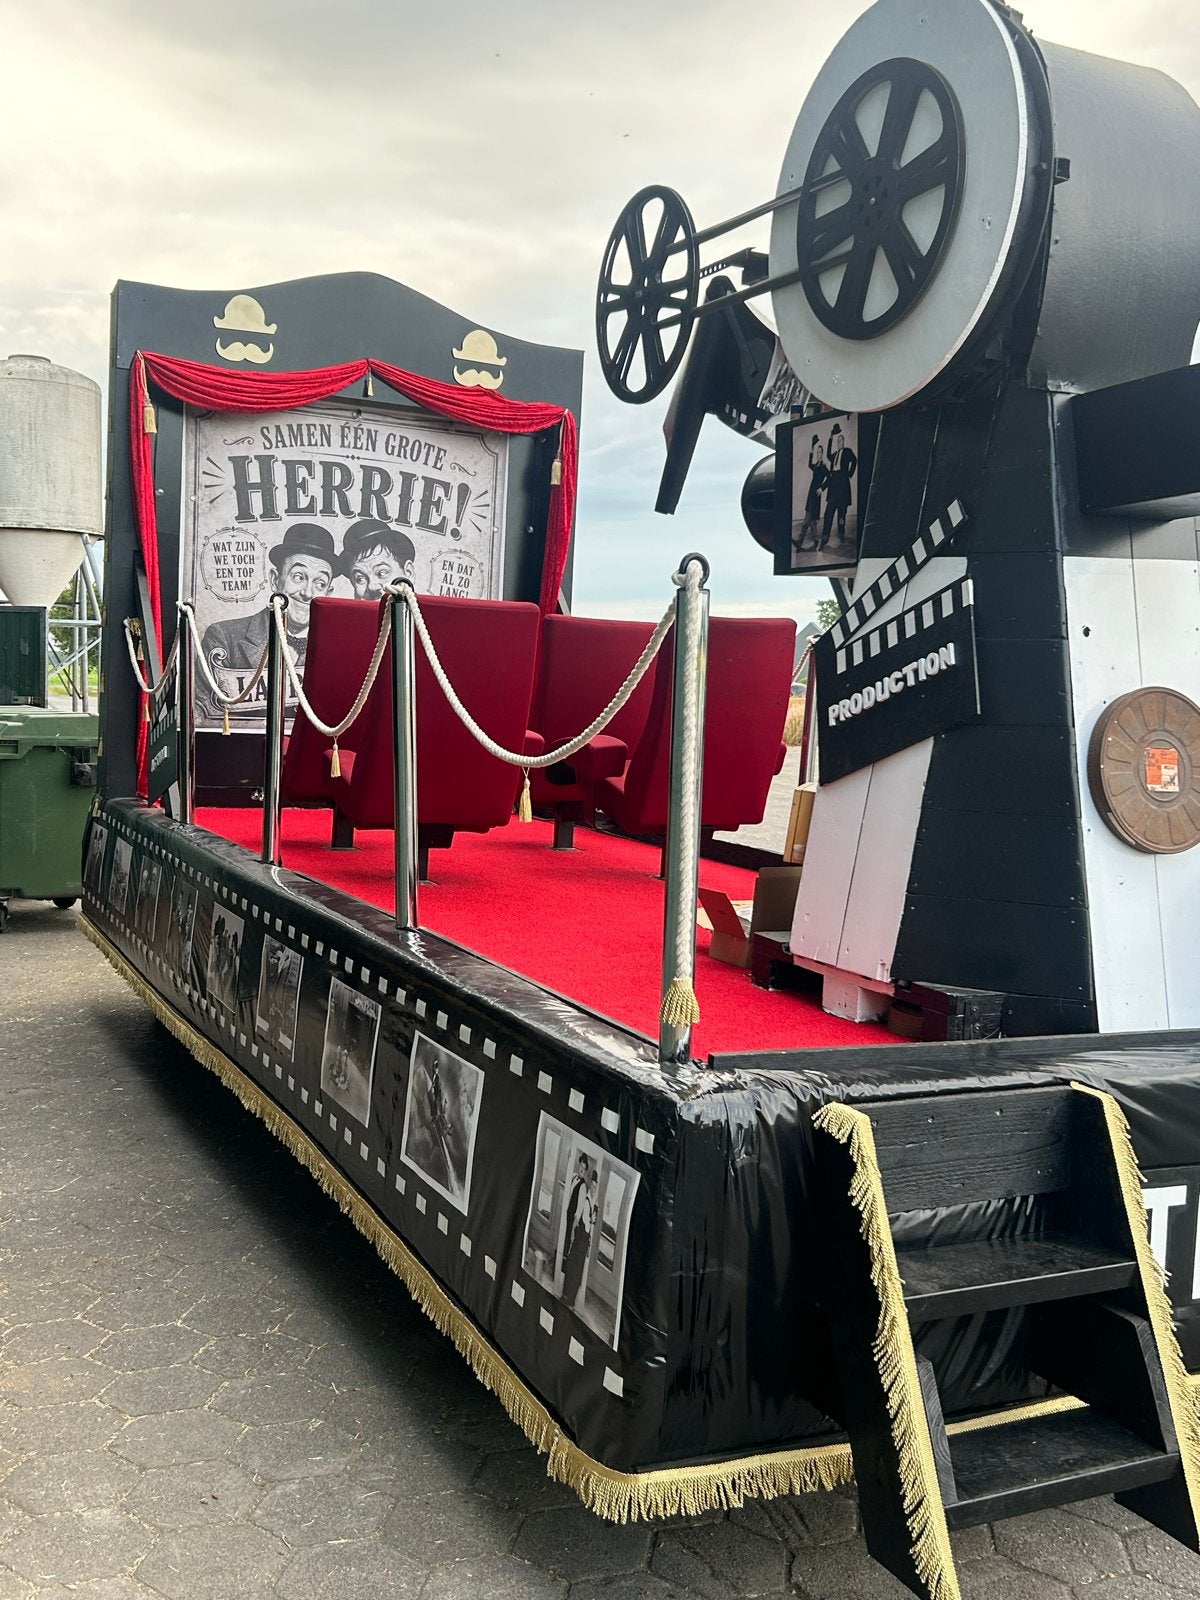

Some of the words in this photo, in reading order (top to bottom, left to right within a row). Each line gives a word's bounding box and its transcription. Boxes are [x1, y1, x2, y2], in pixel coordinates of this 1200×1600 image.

[260, 423, 332, 450] SAMEN
[340, 421, 379, 453] ÉÉN
[384, 432, 448, 472] GROTE
[228, 454, 472, 541] HERRIE!
[212, 541, 233, 553] WAT
[235, 541, 256, 552] ZIJN
[214, 554, 228, 566] WE
[231, 554, 255, 565] TOCH
[442, 559, 455, 572] EN
[457, 563, 475, 577] DAT
[216, 567, 233, 579] EEN
[236, 567, 255, 578] TOP
[442, 572, 454, 586] AL
[457, 576, 470, 589] ZO
[222, 580, 252, 591] TEAM!
[828, 642, 956, 728] PRODUCTION
